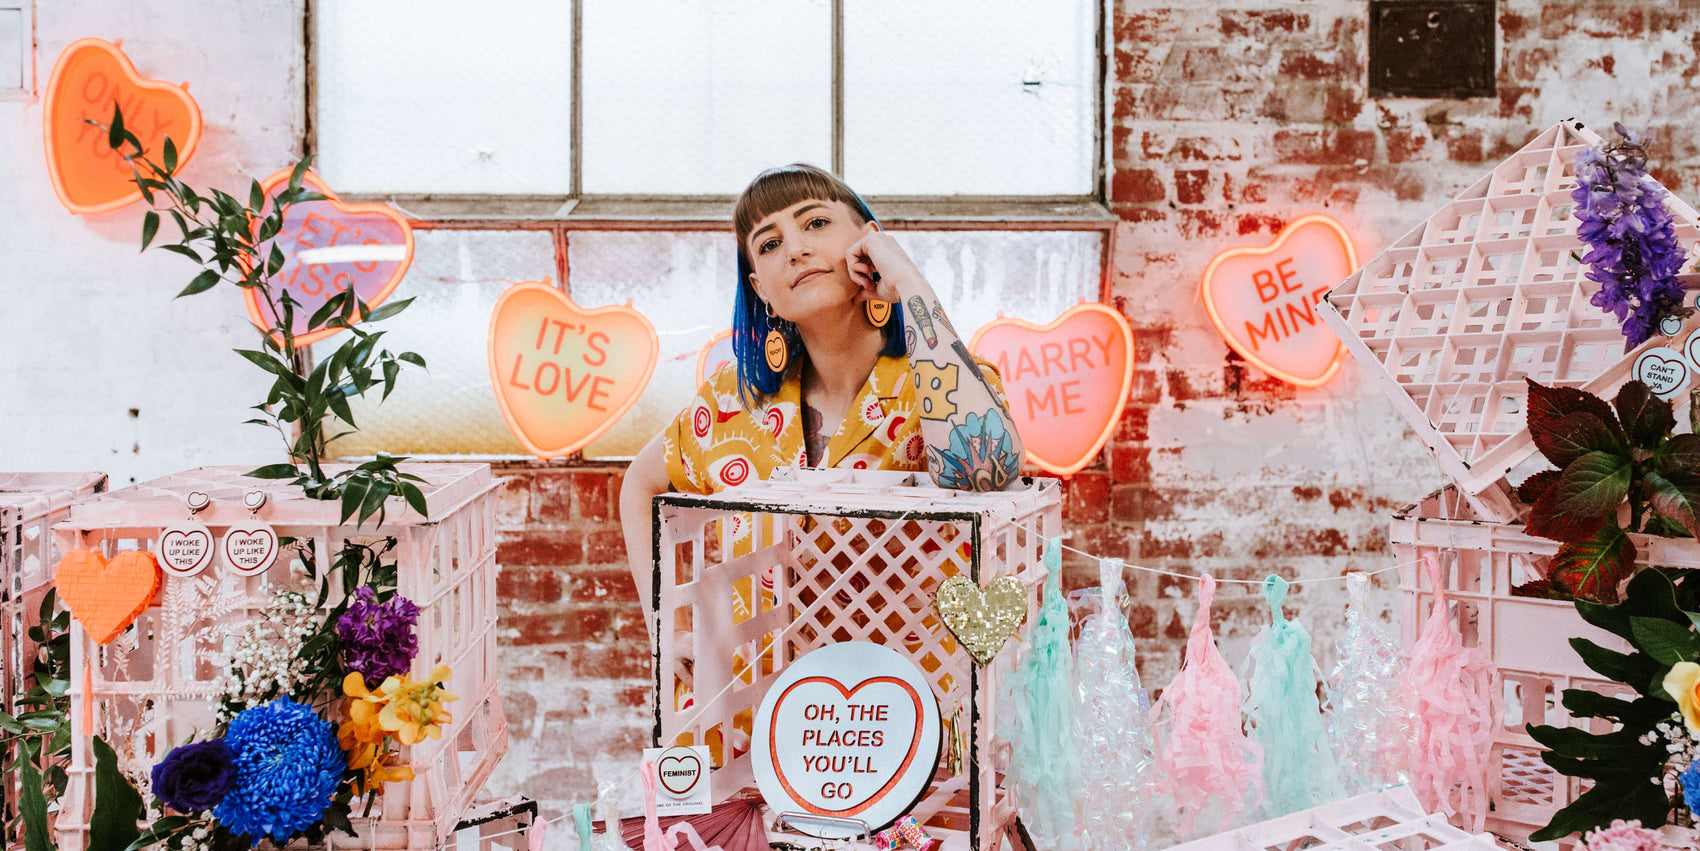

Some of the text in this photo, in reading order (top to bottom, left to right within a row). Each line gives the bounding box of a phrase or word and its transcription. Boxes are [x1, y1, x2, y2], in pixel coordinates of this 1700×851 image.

[279, 211, 383, 273] ET'S
[1252, 257, 1303, 304] BE
[535, 317, 611, 367] IT'S
[1650, 364, 1675, 375] CAN'T
[510, 353, 615, 413] LOVE
[1646, 371, 1674, 384] STAND
[1653, 382, 1663, 390] YA
[1025, 379, 1086, 421] ME
[175, 539, 200, 547] WOKE
[239, 538, 264, 546] WOKE
[181, 548, 200, 556] LIKE
[246, 547, 265, 555] LIKE
[239, 556, 258, 564] THIS
[804, 704, 889, 724] OH, THE
[802, 730, 884, 747] PLACES
[803, 755, 878, 773] YOU'LL
[663, 769, 696, 777] FEMINIST
[821, 782, 853, 800] GO
